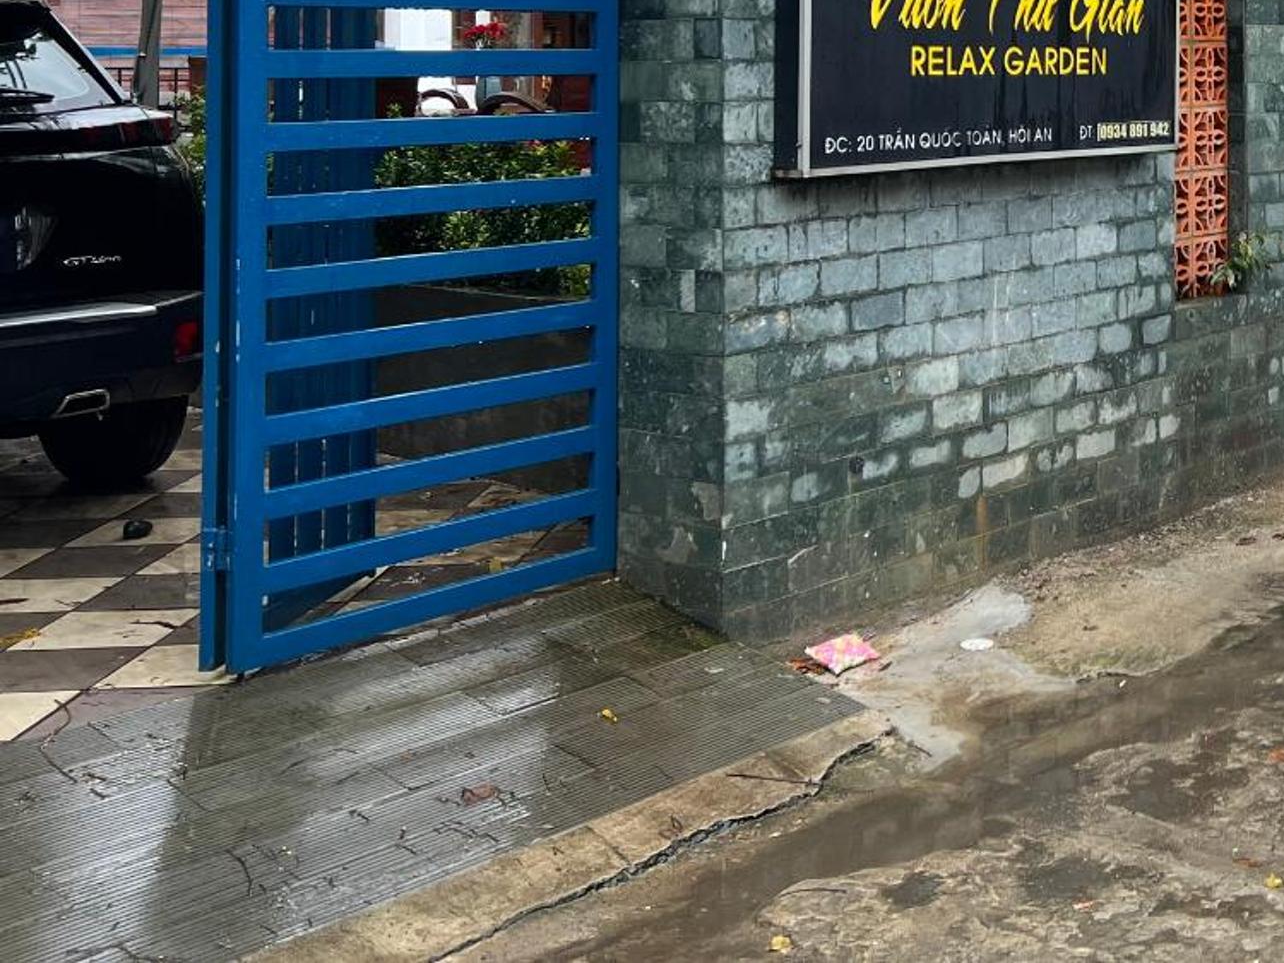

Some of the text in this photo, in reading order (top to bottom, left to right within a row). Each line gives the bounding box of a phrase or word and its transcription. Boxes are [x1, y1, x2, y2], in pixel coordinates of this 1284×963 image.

[910, 45, 1108, 77] RELAX GARDEN
[824, 136, 852, 155] ĐC:
[857, 134, 875, 152] 20
[1033, 127, 1053, 142] AN
[1099, 123, 1127, 139] 0934
[1129, 122, 1148, 138] 891
[1150, 121, 1170, 137] 942
